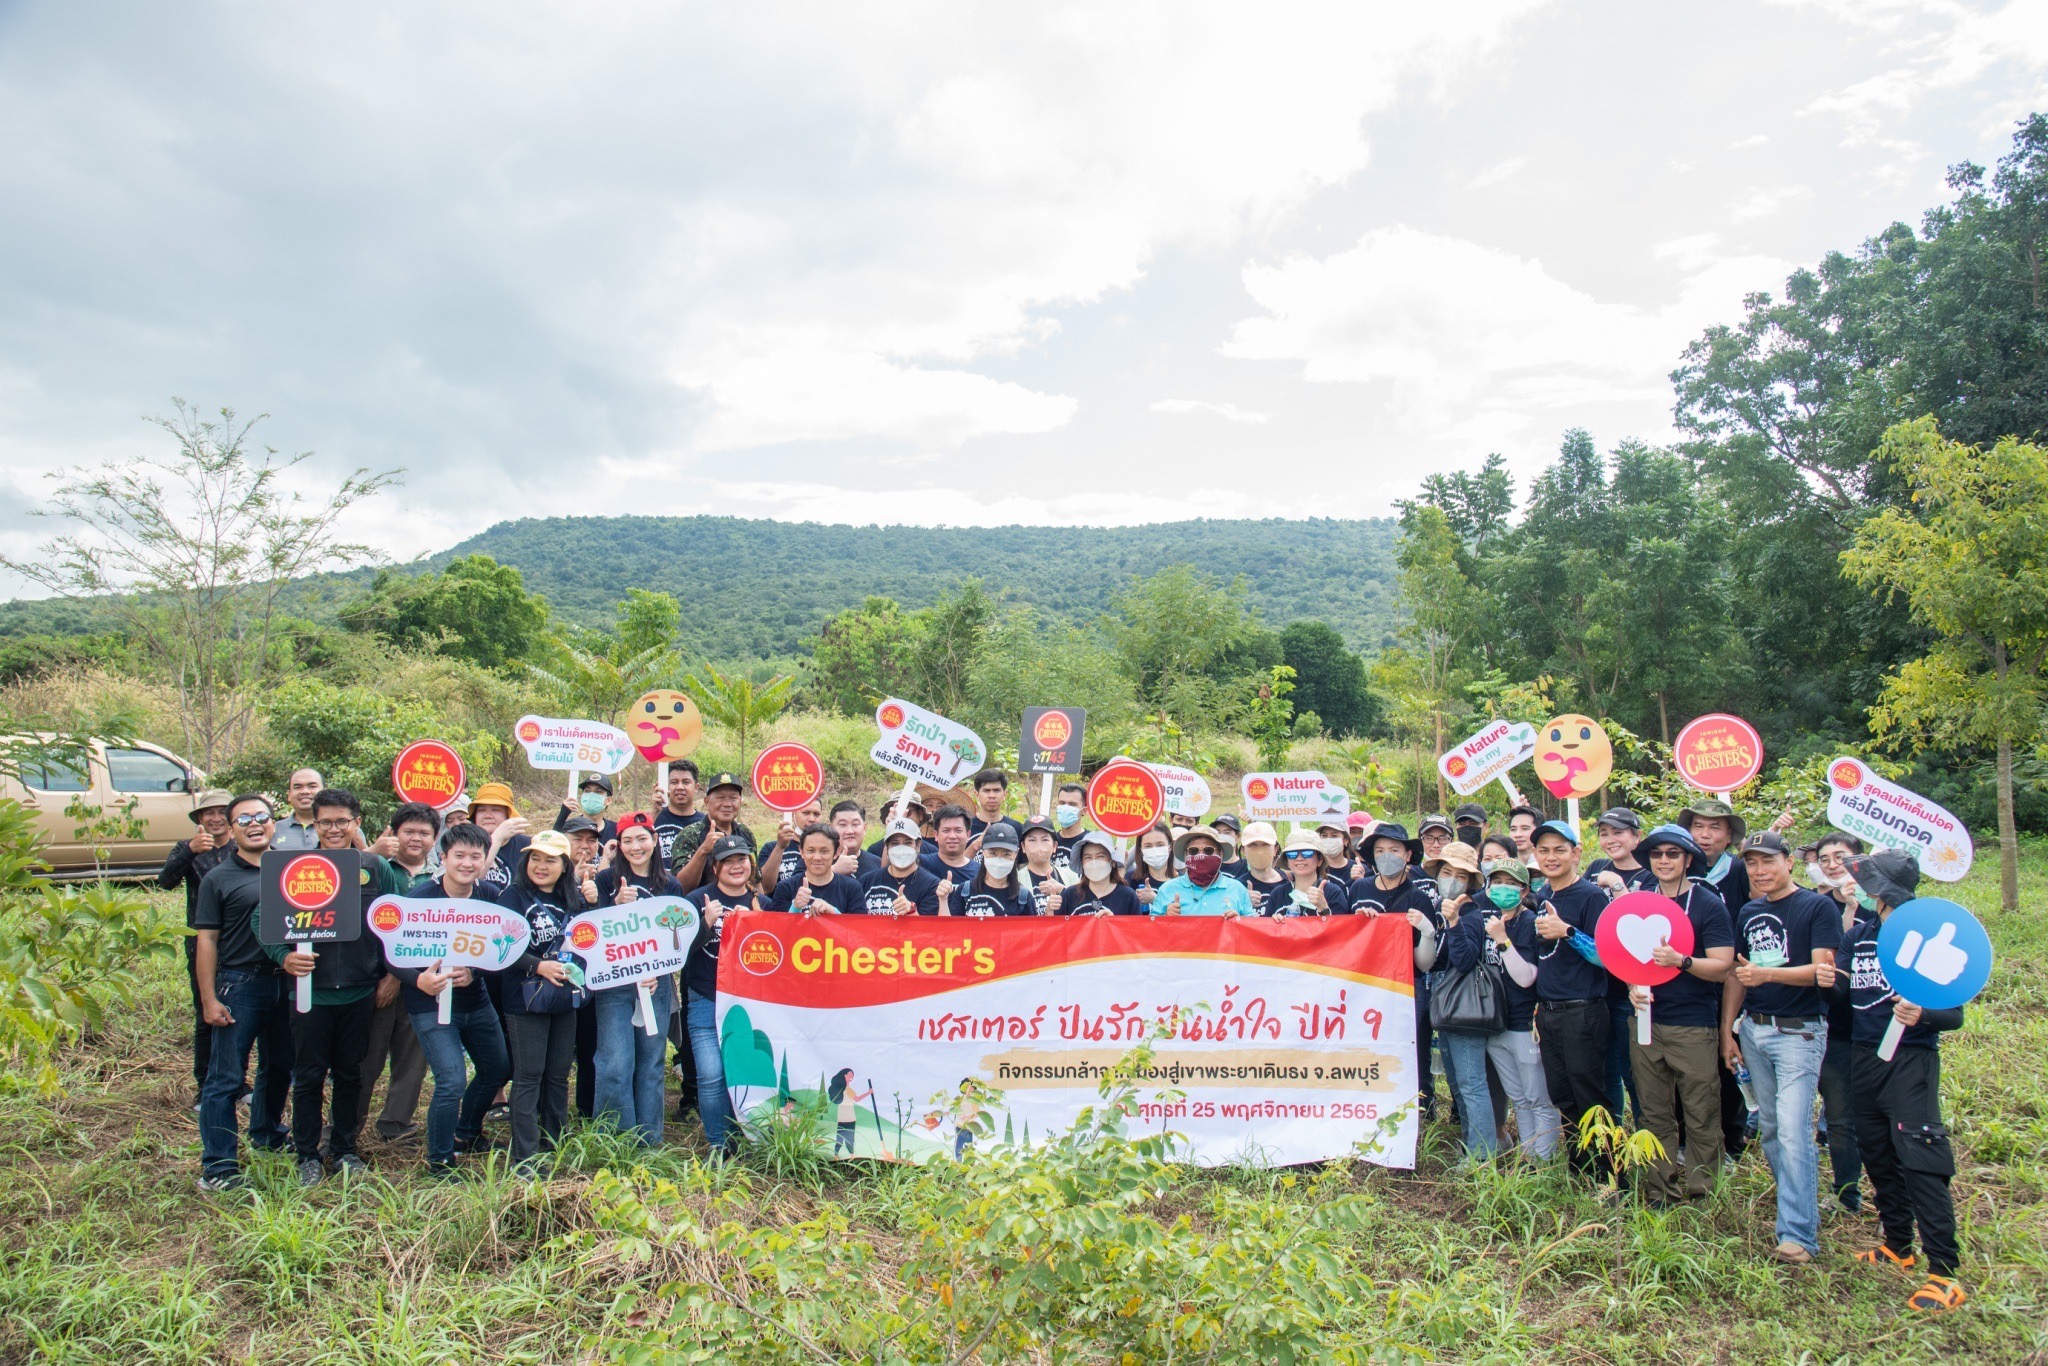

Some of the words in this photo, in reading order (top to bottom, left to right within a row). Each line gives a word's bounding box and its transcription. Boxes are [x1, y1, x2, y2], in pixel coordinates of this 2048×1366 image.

[544, 726, 614, 741] เราไม่เด็ดหรอก
[905, 715, 947, 745] รักป่า
[541, 741, 574, 749] เพราะเรา
[896, 734, 941, 766] รักเขา
[1464, 725, 1509, 758] Nature
[535, 751, 574, 763] รักต้นไม้
[1040, 751, 1066, 764] 1145
[1474, 757, 1485, 767] is
[1485, 746, 1501, 761] my
[1685, 745, 1753, 776] CHESTER'S
[401, 770, 456, 796] CHESTER'S
[1460, 752, 1516, 792] happiness
[760, 773, 816, 796] CHESTER'S
[1273, 777, 1325, 790] Nature
[1095, 793, 1153, 821] CHESTER'S
[1277, 793, 1287, 802] is
[1289, 794, 1307, 804] my
[1863, 783, 1954, 832] สูดลมให้เต็มปอด
[1252, 806, 1317, 818] happiness
[288, 879, 334, 897] CHESTER'S
[295, 911, 336, 929] 1145
[407, 909, 501, 925] เราไม่เด็ดหรอก
[602, 913, 651, 939] รักป่า
[403, 929, 447, 939] เพราะเรา
[394, 943, 446, 958] รักต้นไม้
[605, 938, 658, 963] รักเขา
[790, 937, 996, 975] Chester's
[918, 1004, 1047, 1042] เชสเตอร์
[1058, 1001, 1145, 1042] ปันรัก
[1291, 989, 1347, 1041] ปีที่
[1314, 1062, 1380, 1086] จ.ลพบุรี
[1192, 1102, 1215, 1118] 25
[1221, 1100, 1325, 1121] พฤศจิกายน
[1330, 1103, 1378, 1119] 2565
